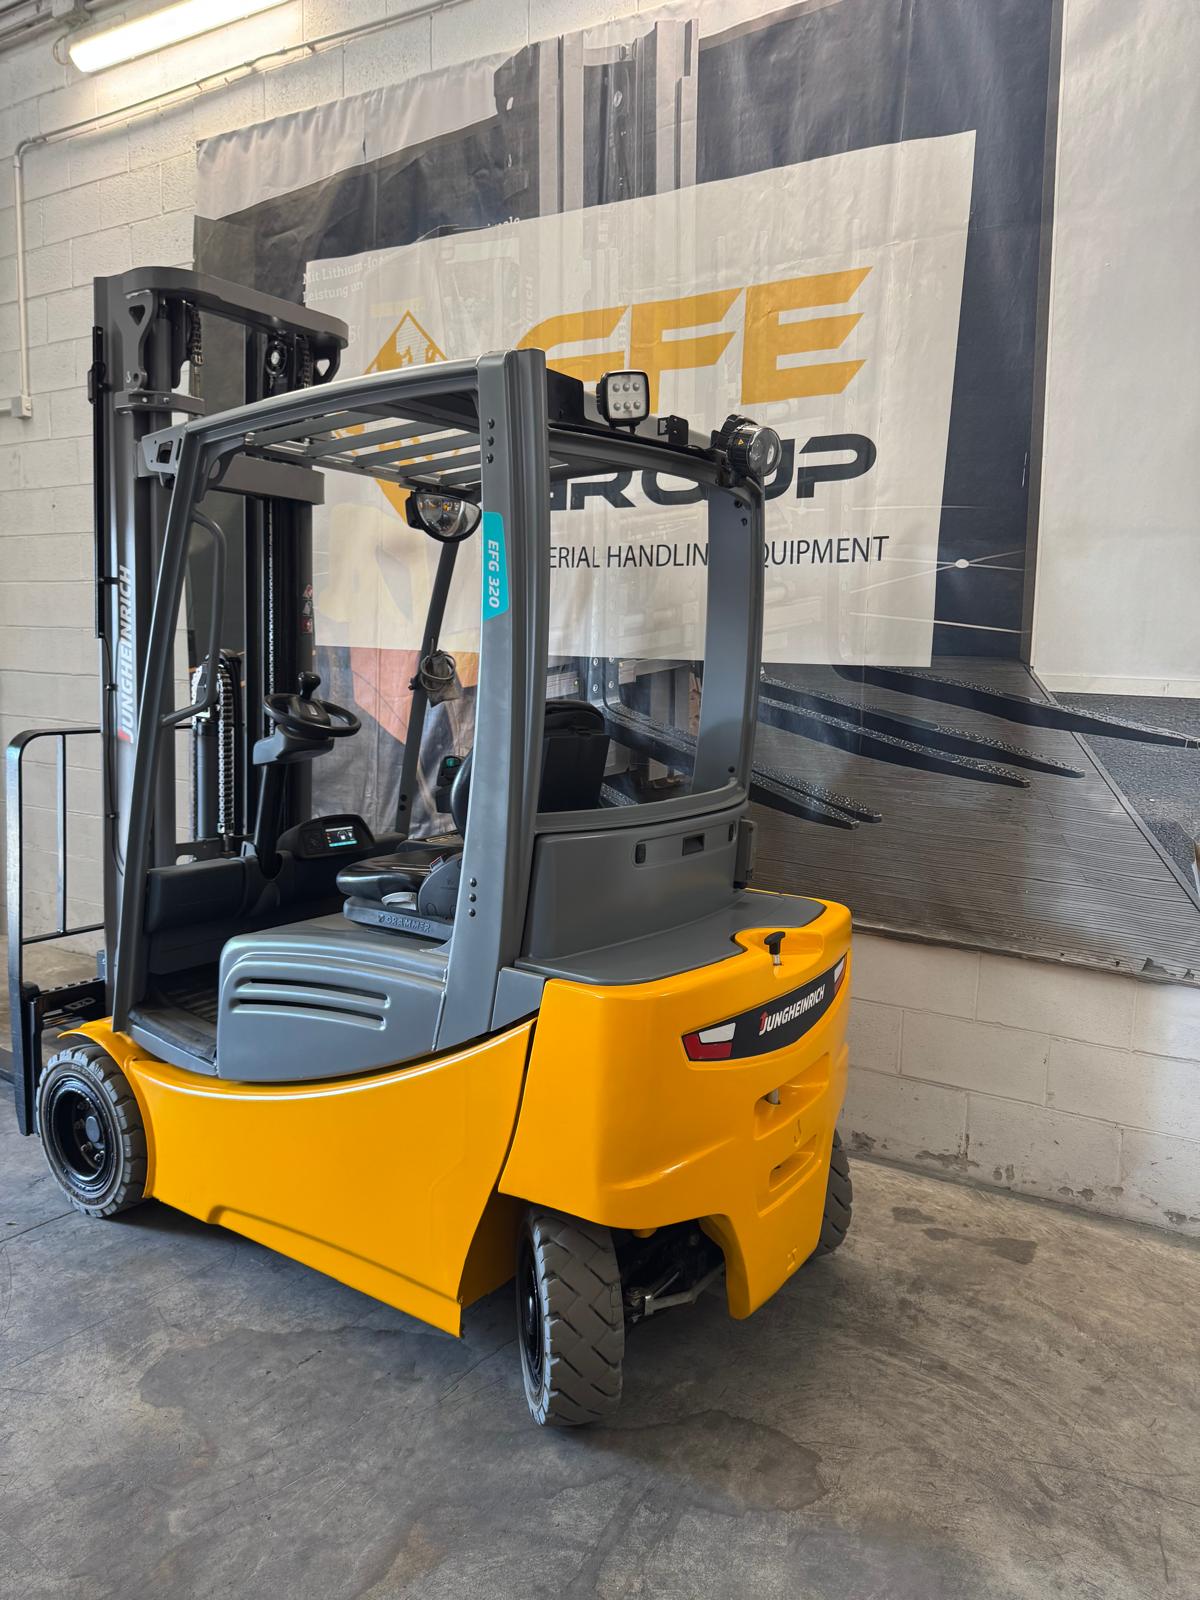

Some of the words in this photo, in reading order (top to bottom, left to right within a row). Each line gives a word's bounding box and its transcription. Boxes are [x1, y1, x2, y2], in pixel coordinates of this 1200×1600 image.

[488, 539, 500, 572] EFG
[607, 542, 709, 568] HANDLIN
[488, 575, 500, 608] 320
[117, 564, 135, 745] JUNGHEINRICH
[758, 983, 826, 1036] JUNGHEINRICH
